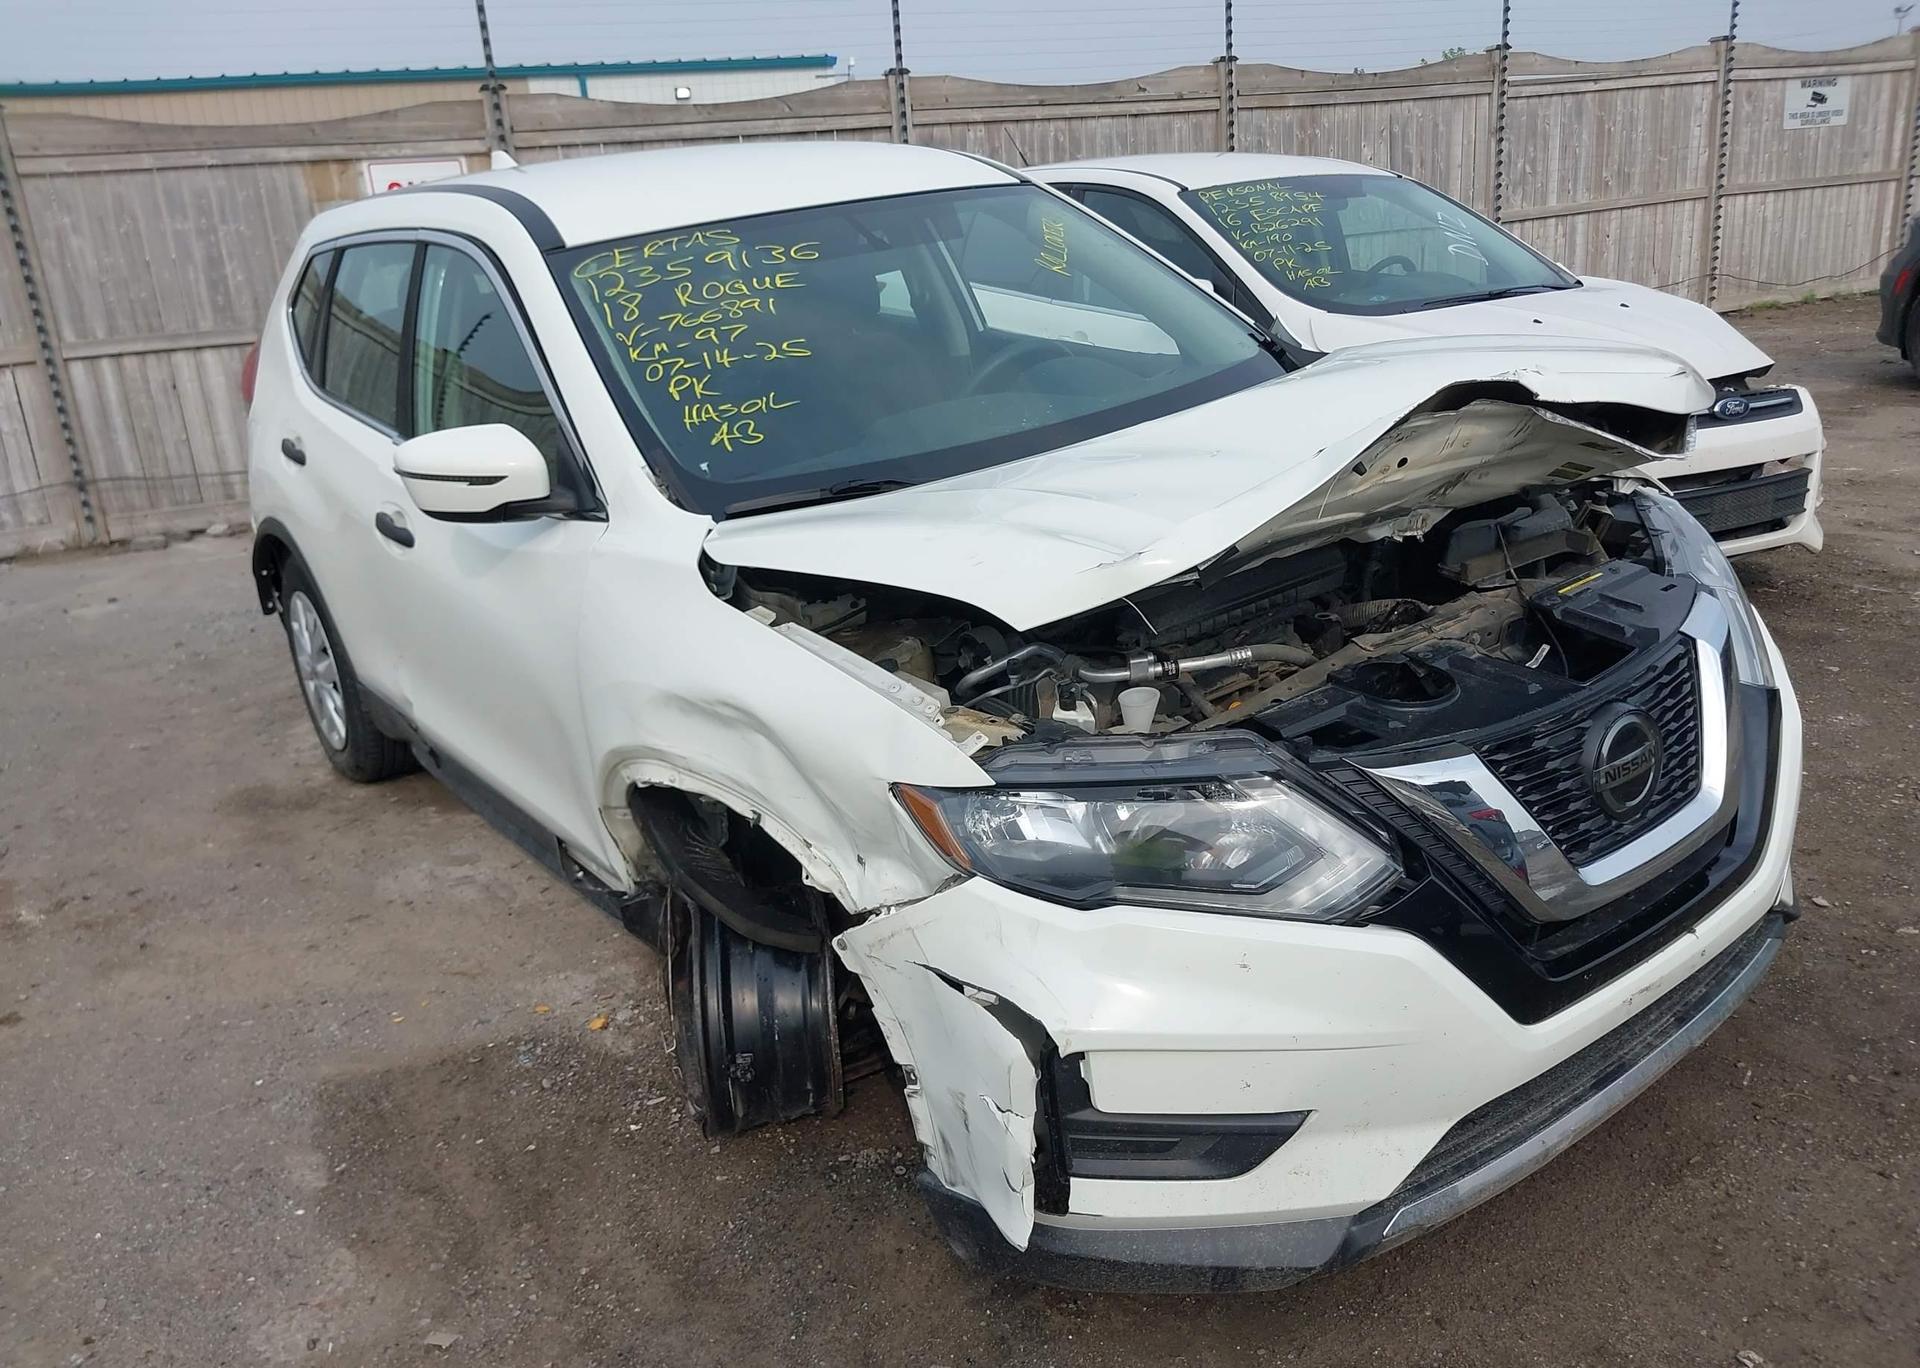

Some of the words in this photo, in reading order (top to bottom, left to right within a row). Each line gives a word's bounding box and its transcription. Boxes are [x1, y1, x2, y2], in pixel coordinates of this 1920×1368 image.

[1800, 78, 1838, 89] WARNING
[1199, 182, 1293, 203] PERSONAL
[1218, 213, 1242, 229] 16
[1250, 203, 1327, 221] ESCAPE
[573, 229, 740, 279] CERTAS
[1273, 257, 1300, 271] PK
[603, 292, 643, 329] 18
[675, 272, 807, 307] ROGUE
[646, 339, 812, 381] 07-14-25
[668, 374, 722, 400] PK
[1725, 401, 1745, 415] Ford
[1604, 748, 1656, 784] NISSAN
